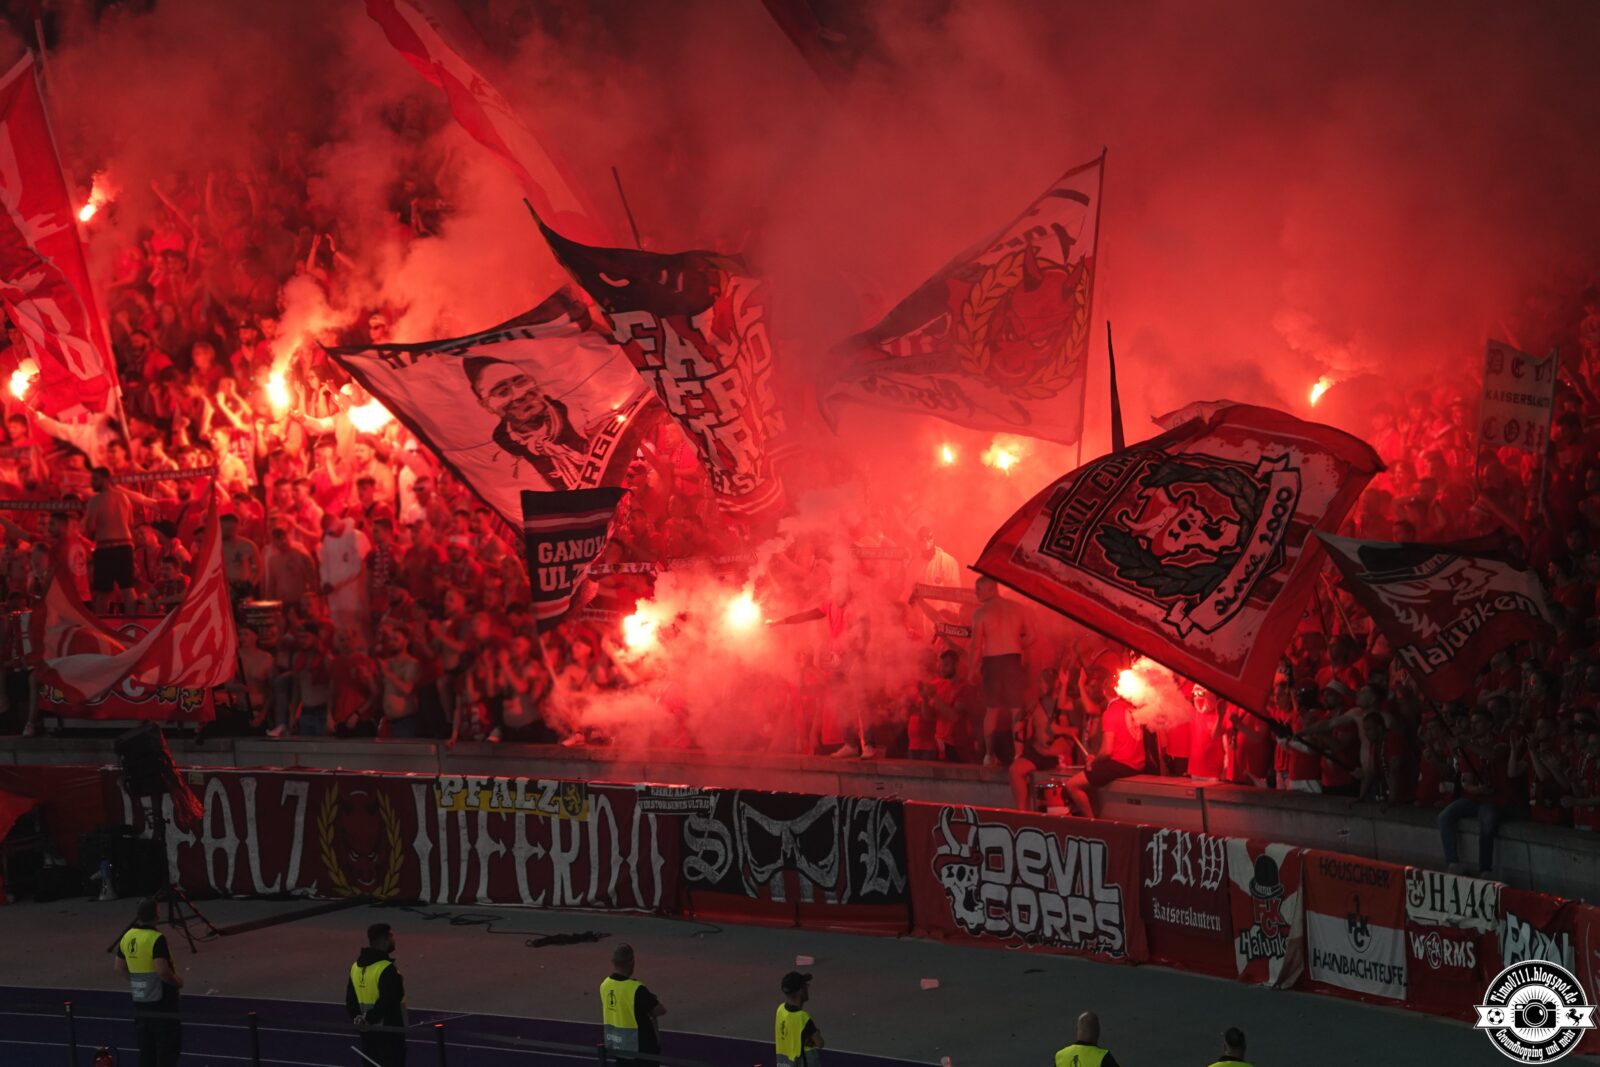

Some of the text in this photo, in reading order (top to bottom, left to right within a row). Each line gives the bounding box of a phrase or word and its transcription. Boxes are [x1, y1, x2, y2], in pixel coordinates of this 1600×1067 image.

[1258, 487, 1293, 546] 2000
[438, 778, 561, 815] PFALZ
[980, 884, 1125, 952] CORPS
